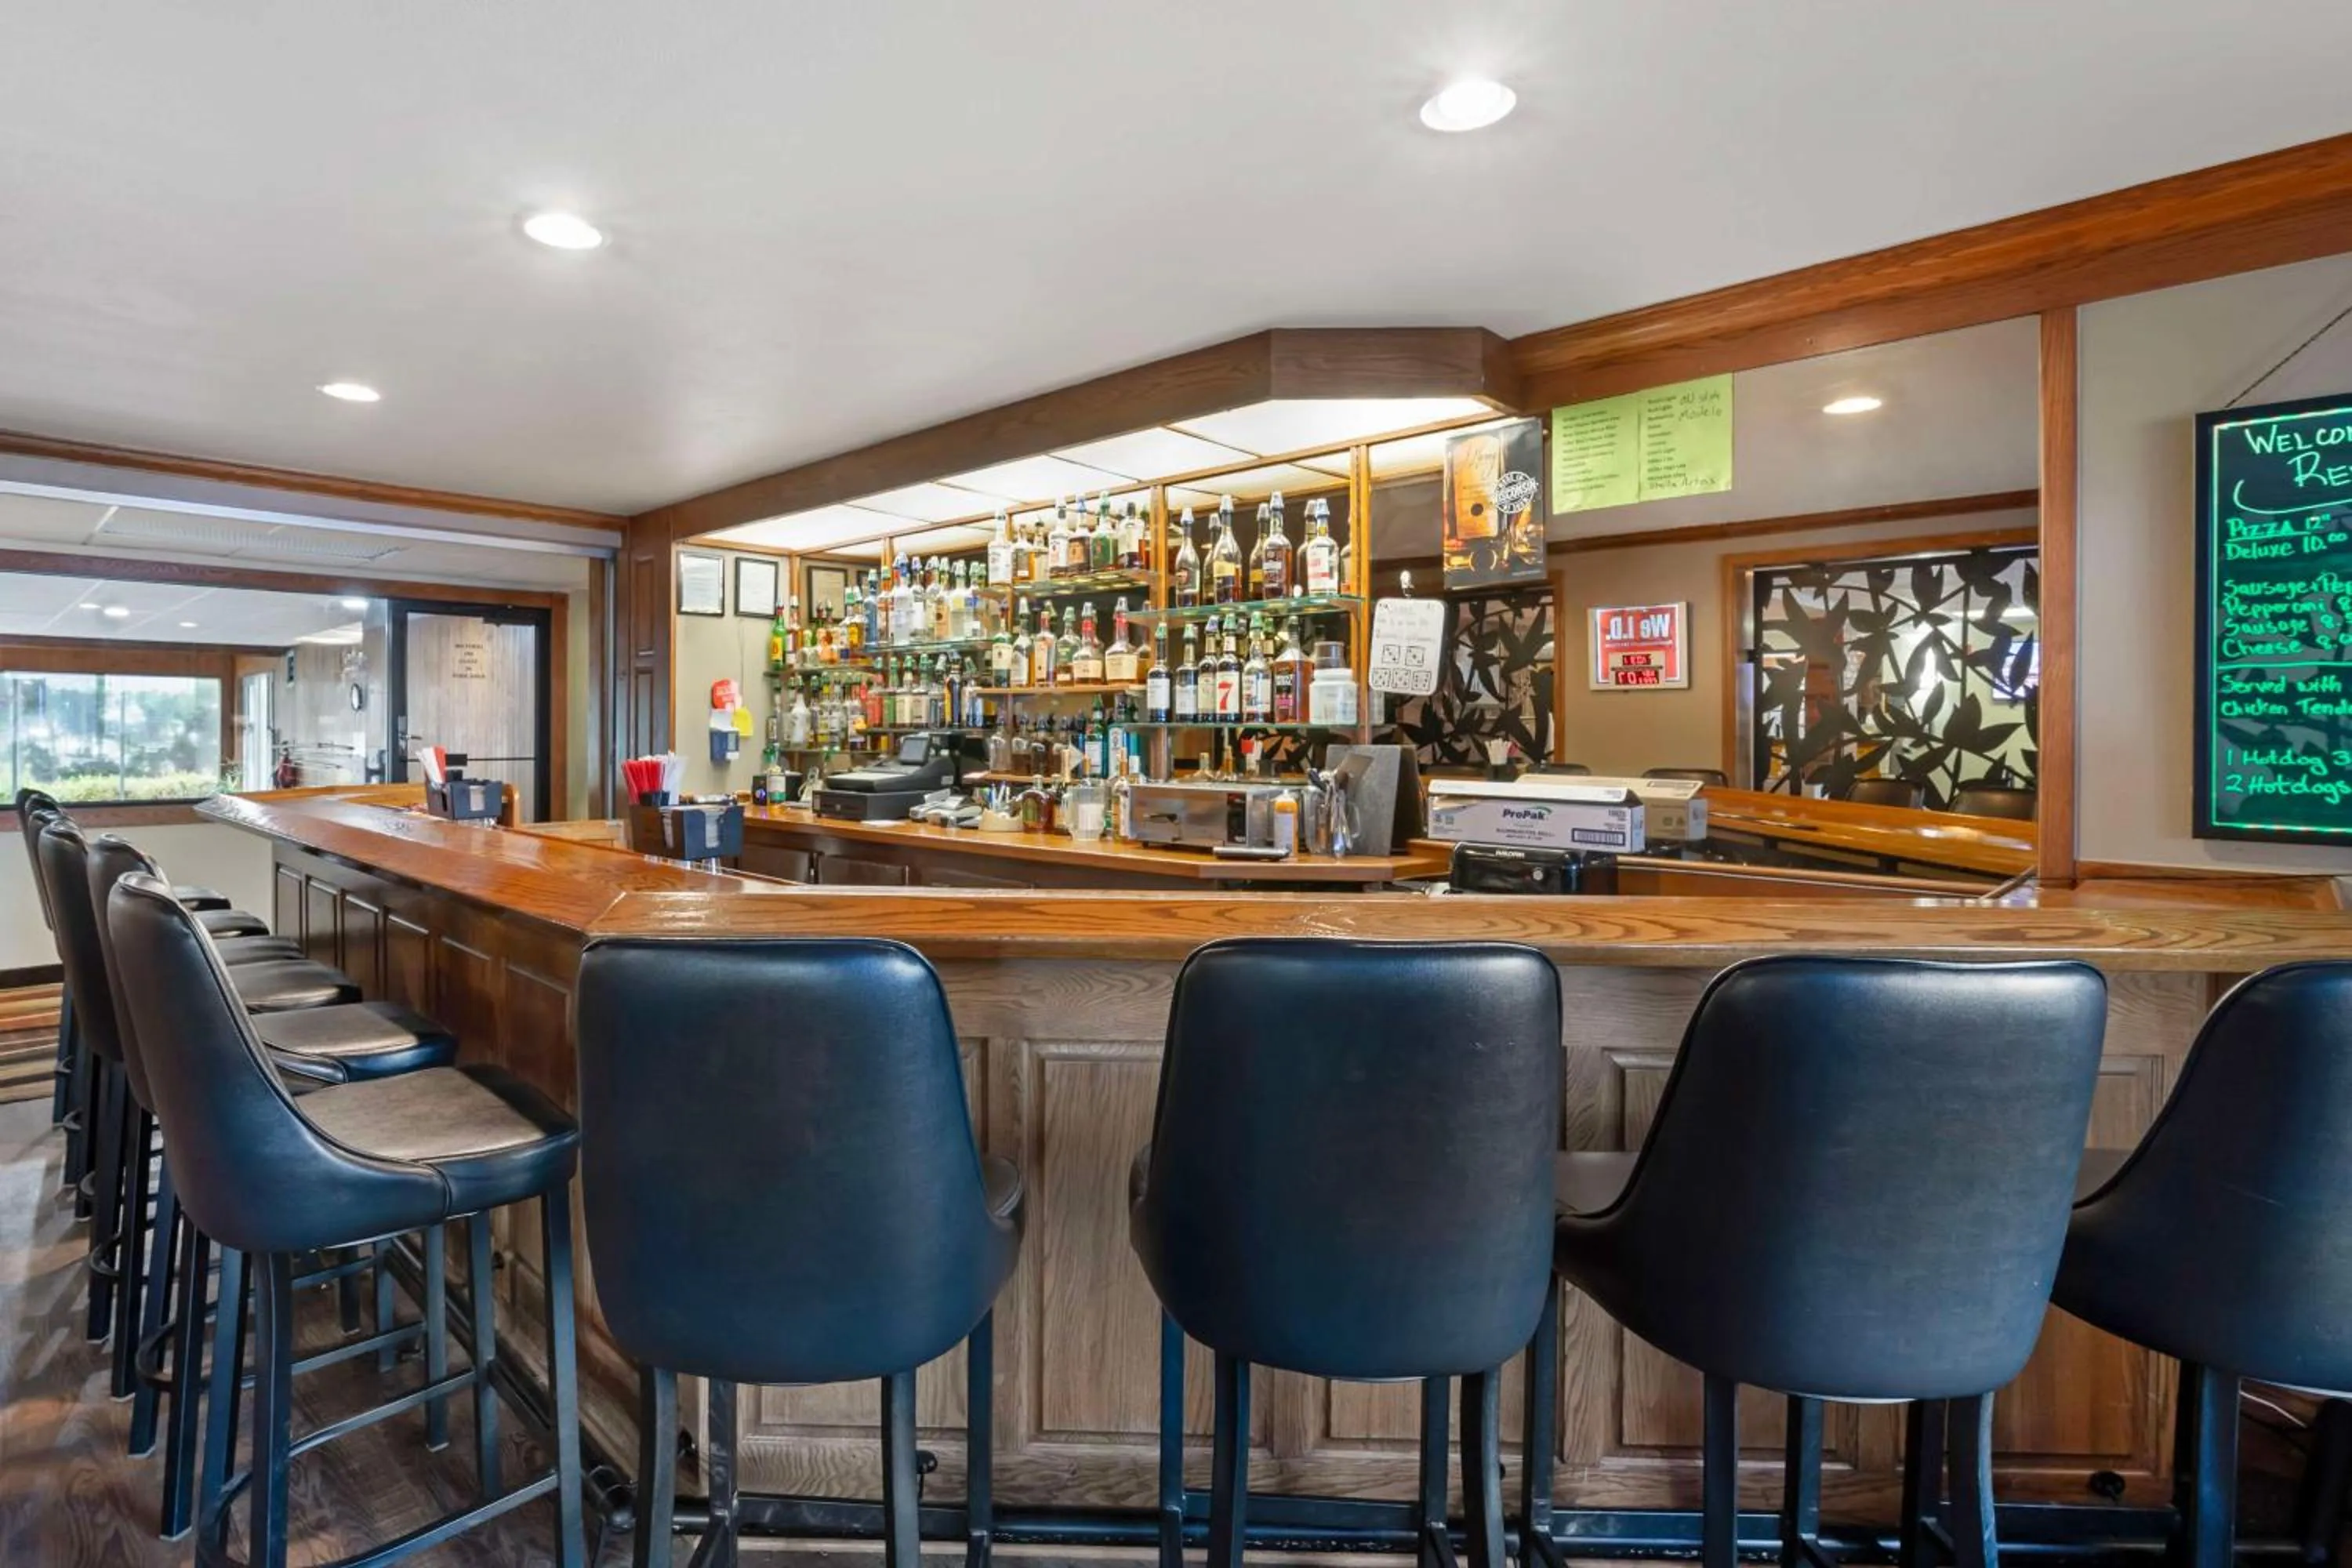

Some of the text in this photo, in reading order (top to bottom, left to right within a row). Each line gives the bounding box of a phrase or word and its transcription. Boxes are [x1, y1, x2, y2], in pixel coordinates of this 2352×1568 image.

[2286, 451, 2352, 487] RE
[2225, 540, 2296, 560] Deluxe
[2221, 637, 2303, 659] Cheese
[2220, 674, 2343, 694] Served with
[1218, 681, 1234, 711] 7
[2220, 698, 2288, 717] Chicken
[2242, 749, 2329, 776] Hotdog
[2224, 773, 2352, 805] 2 Hotdogs
[1502, 808, 1545, 821] ProPak
